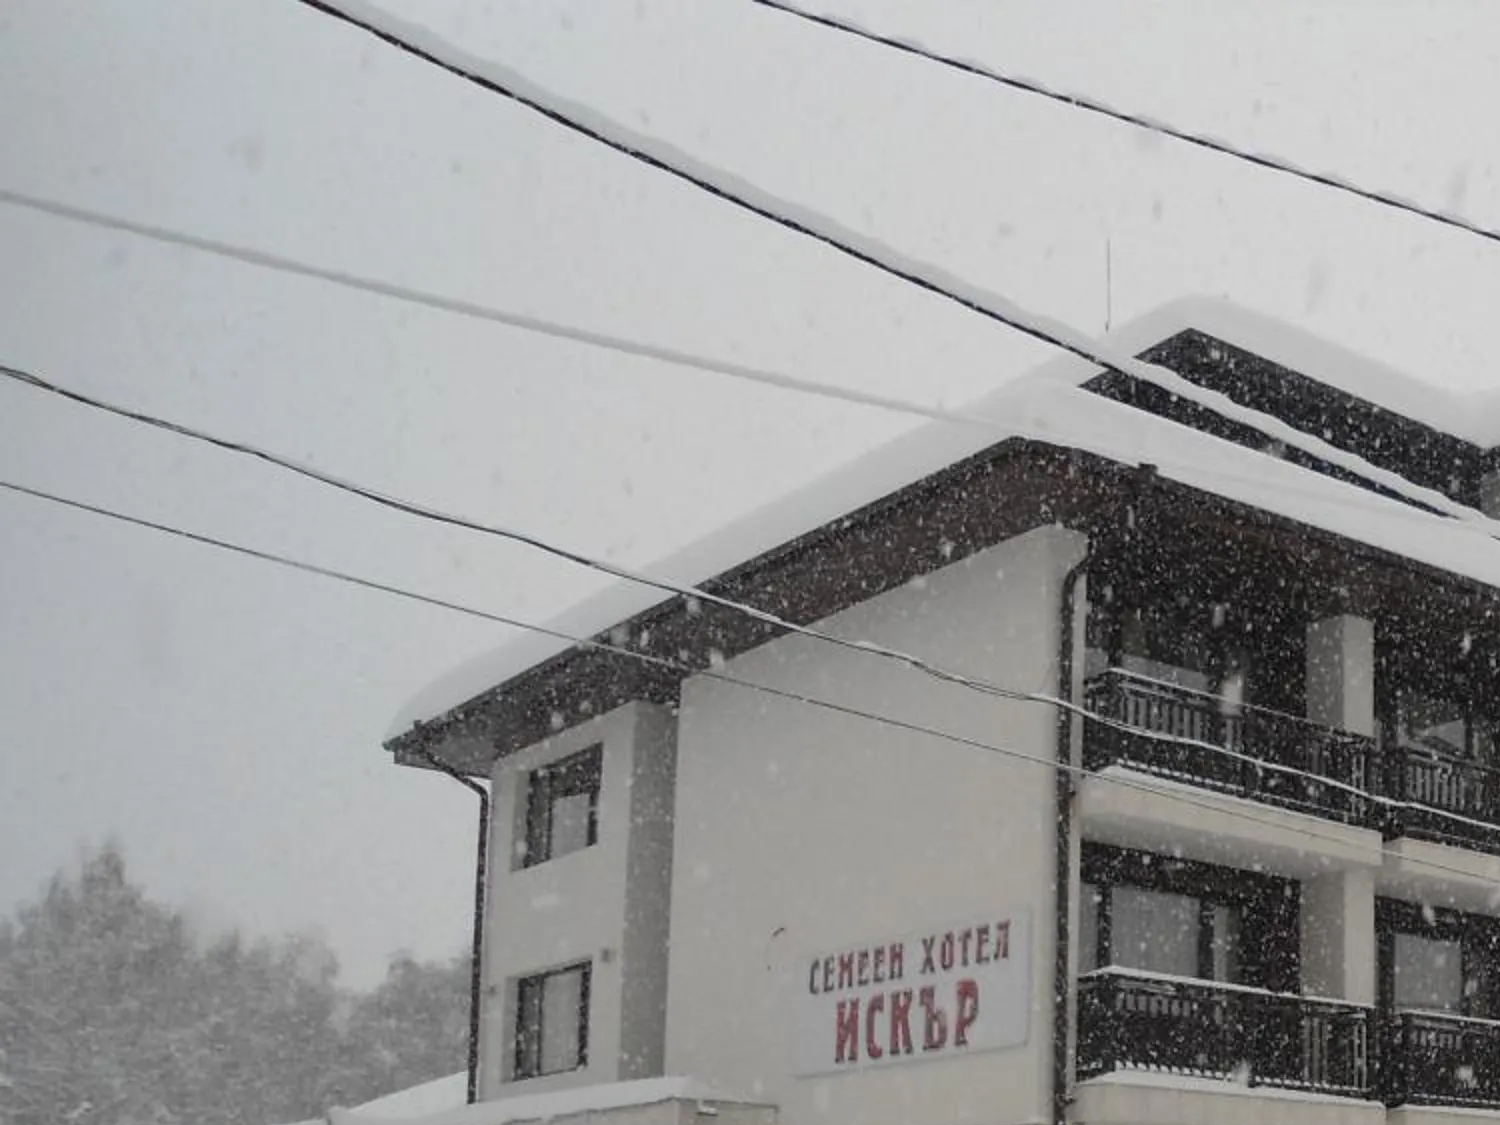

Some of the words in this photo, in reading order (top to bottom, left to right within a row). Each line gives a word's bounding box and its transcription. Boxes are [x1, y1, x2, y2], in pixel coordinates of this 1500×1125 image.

[809, 942, 904, 995] СЕМЕЕН
[919, 919, 1011, 975] ХОТЕЛ
[835, 978, 979, 1063] ИСКЪР
